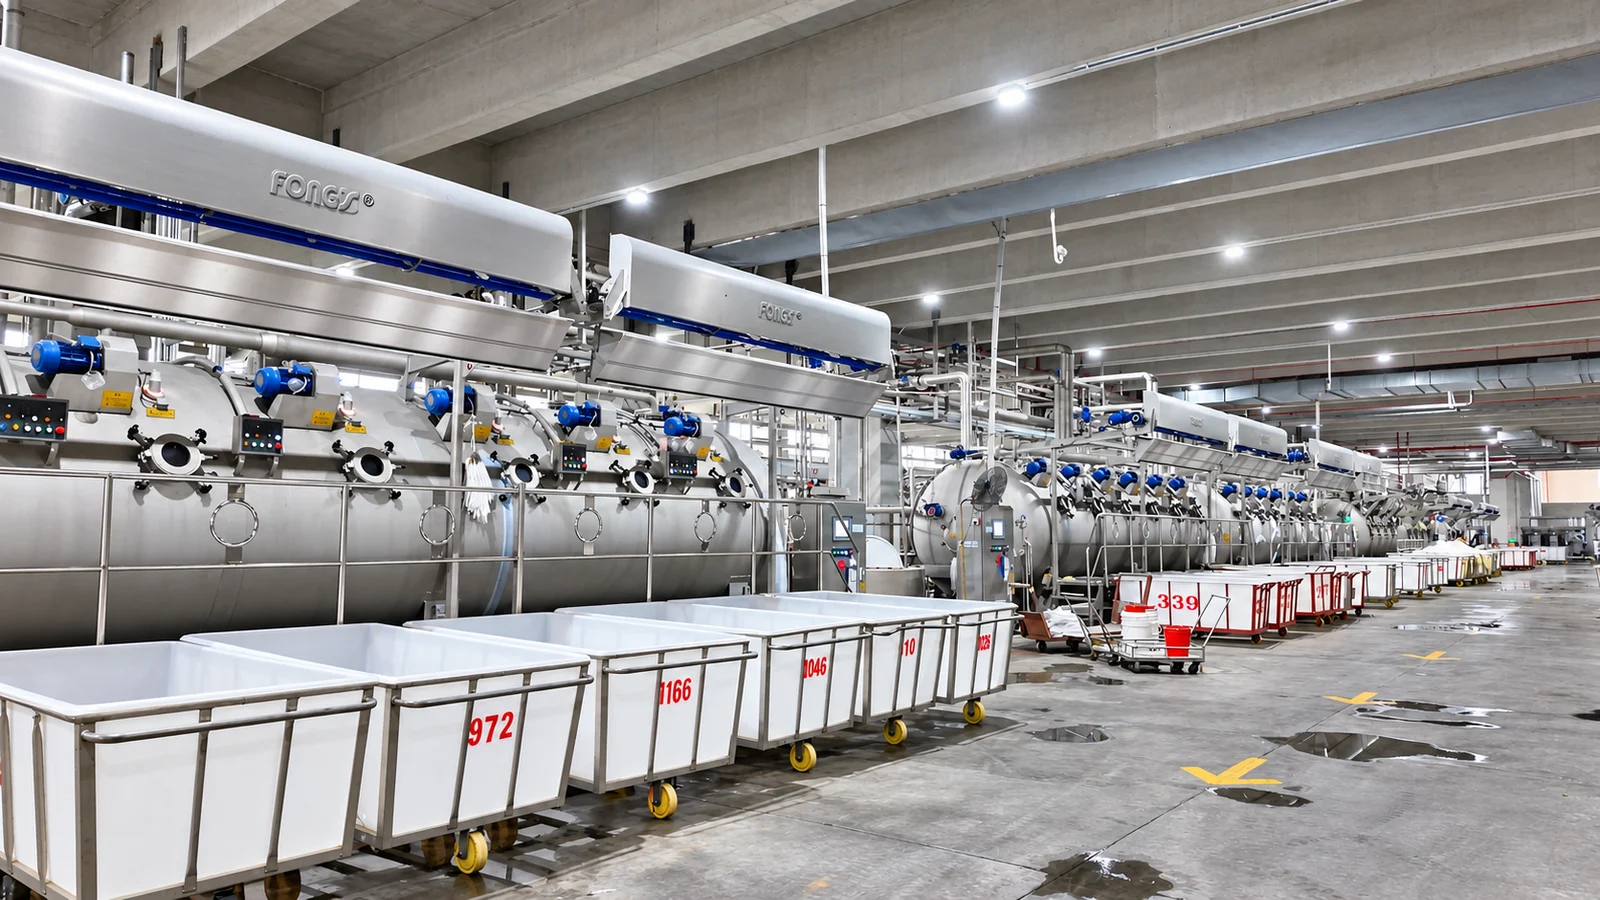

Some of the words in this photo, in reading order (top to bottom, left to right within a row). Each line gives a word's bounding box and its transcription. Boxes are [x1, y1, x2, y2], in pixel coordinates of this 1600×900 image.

[1157, 593, 1199, 611] 339
[659, 677, 692, 705] 1166
[468, 711, 514, 746] 972
